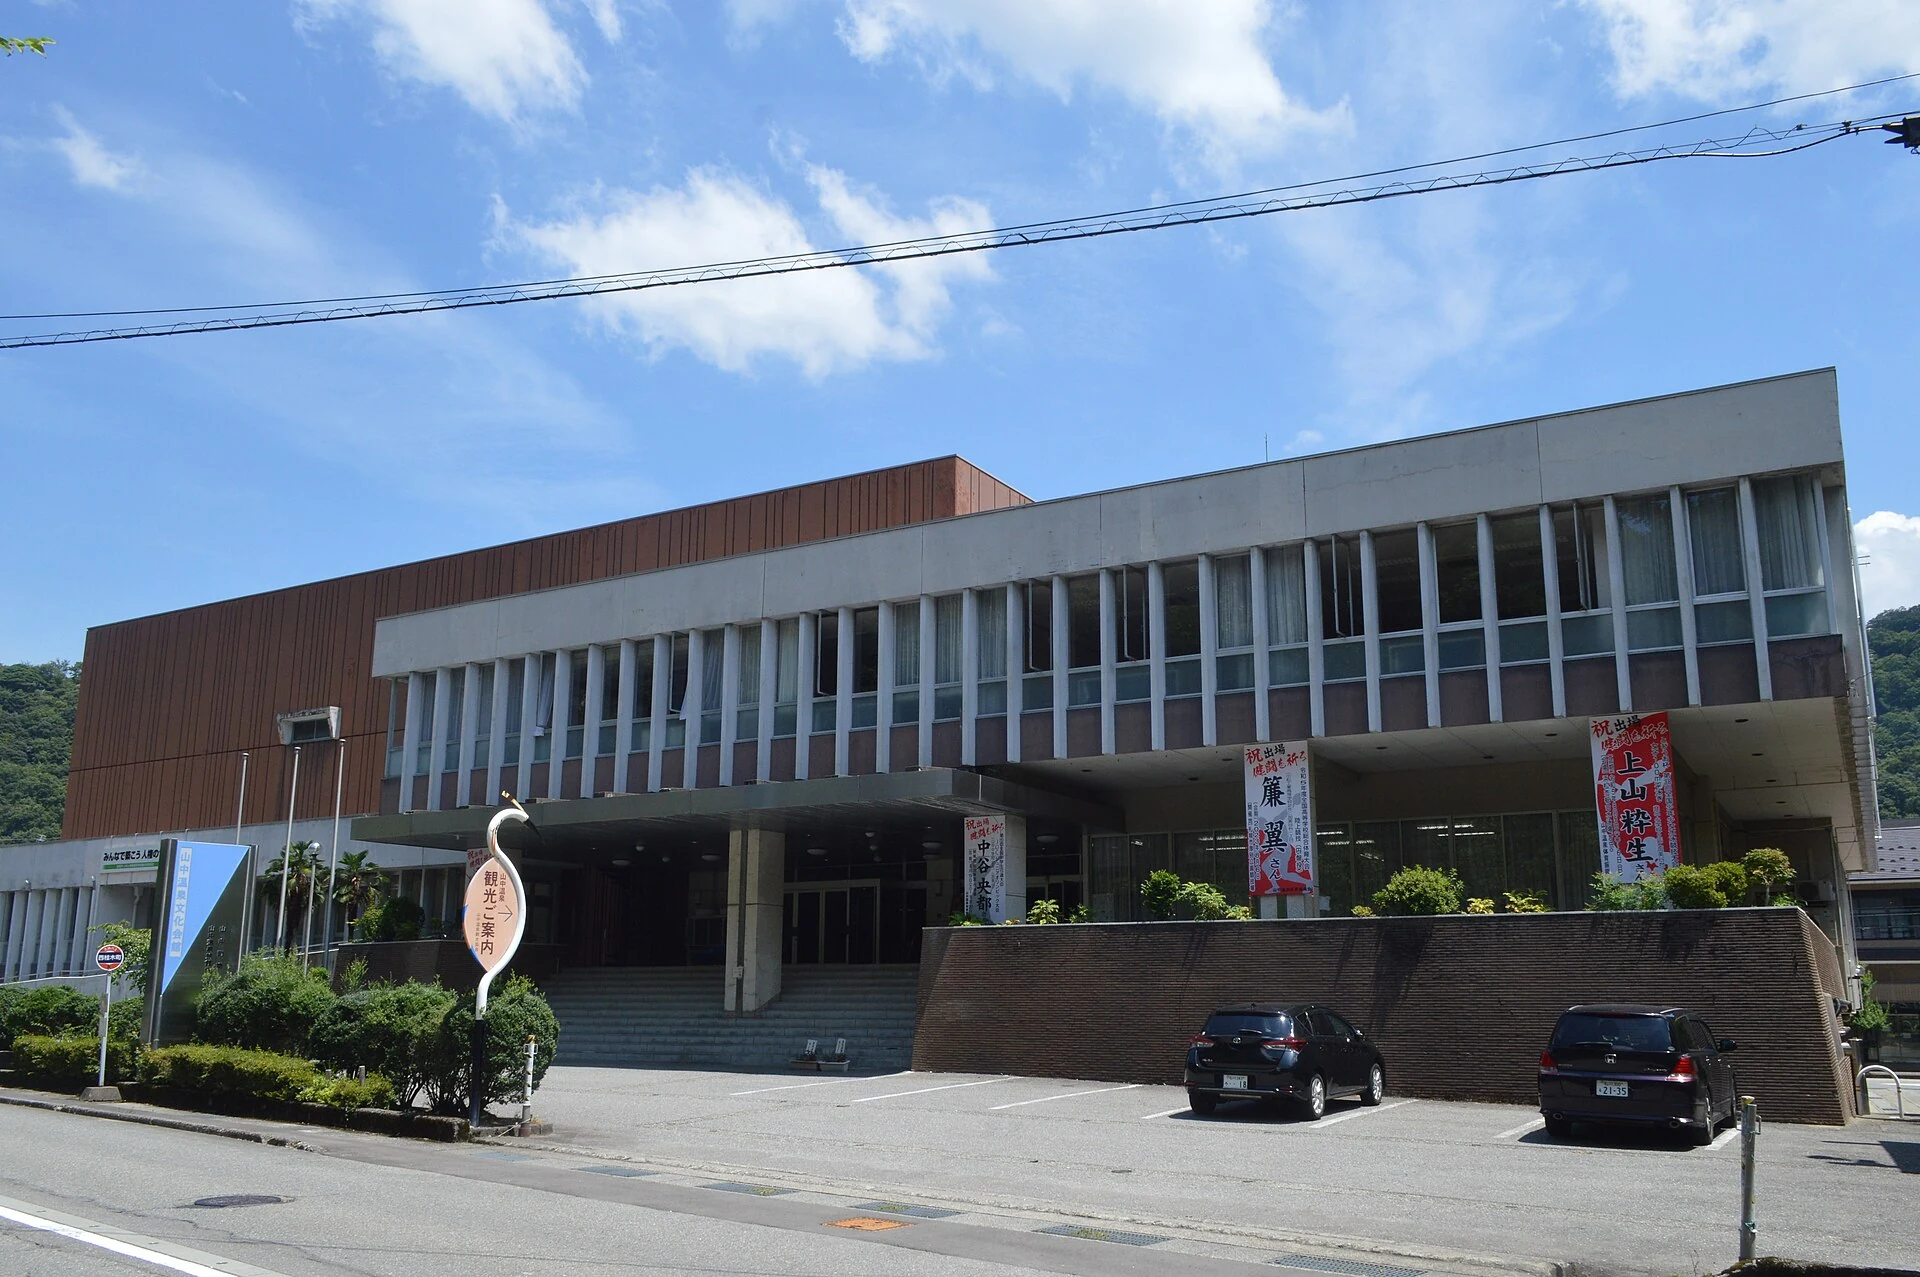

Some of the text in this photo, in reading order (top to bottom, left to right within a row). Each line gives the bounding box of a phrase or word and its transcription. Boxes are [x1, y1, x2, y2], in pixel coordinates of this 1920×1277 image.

[1259, 776, 1288, 880] 簾 翼 さん
[171, 851, 190, 952] 山中温泉文化会館
[480, 870, 498, 955] 観光ご案内
[1603, 1086, 1627, 1096] 21-35
